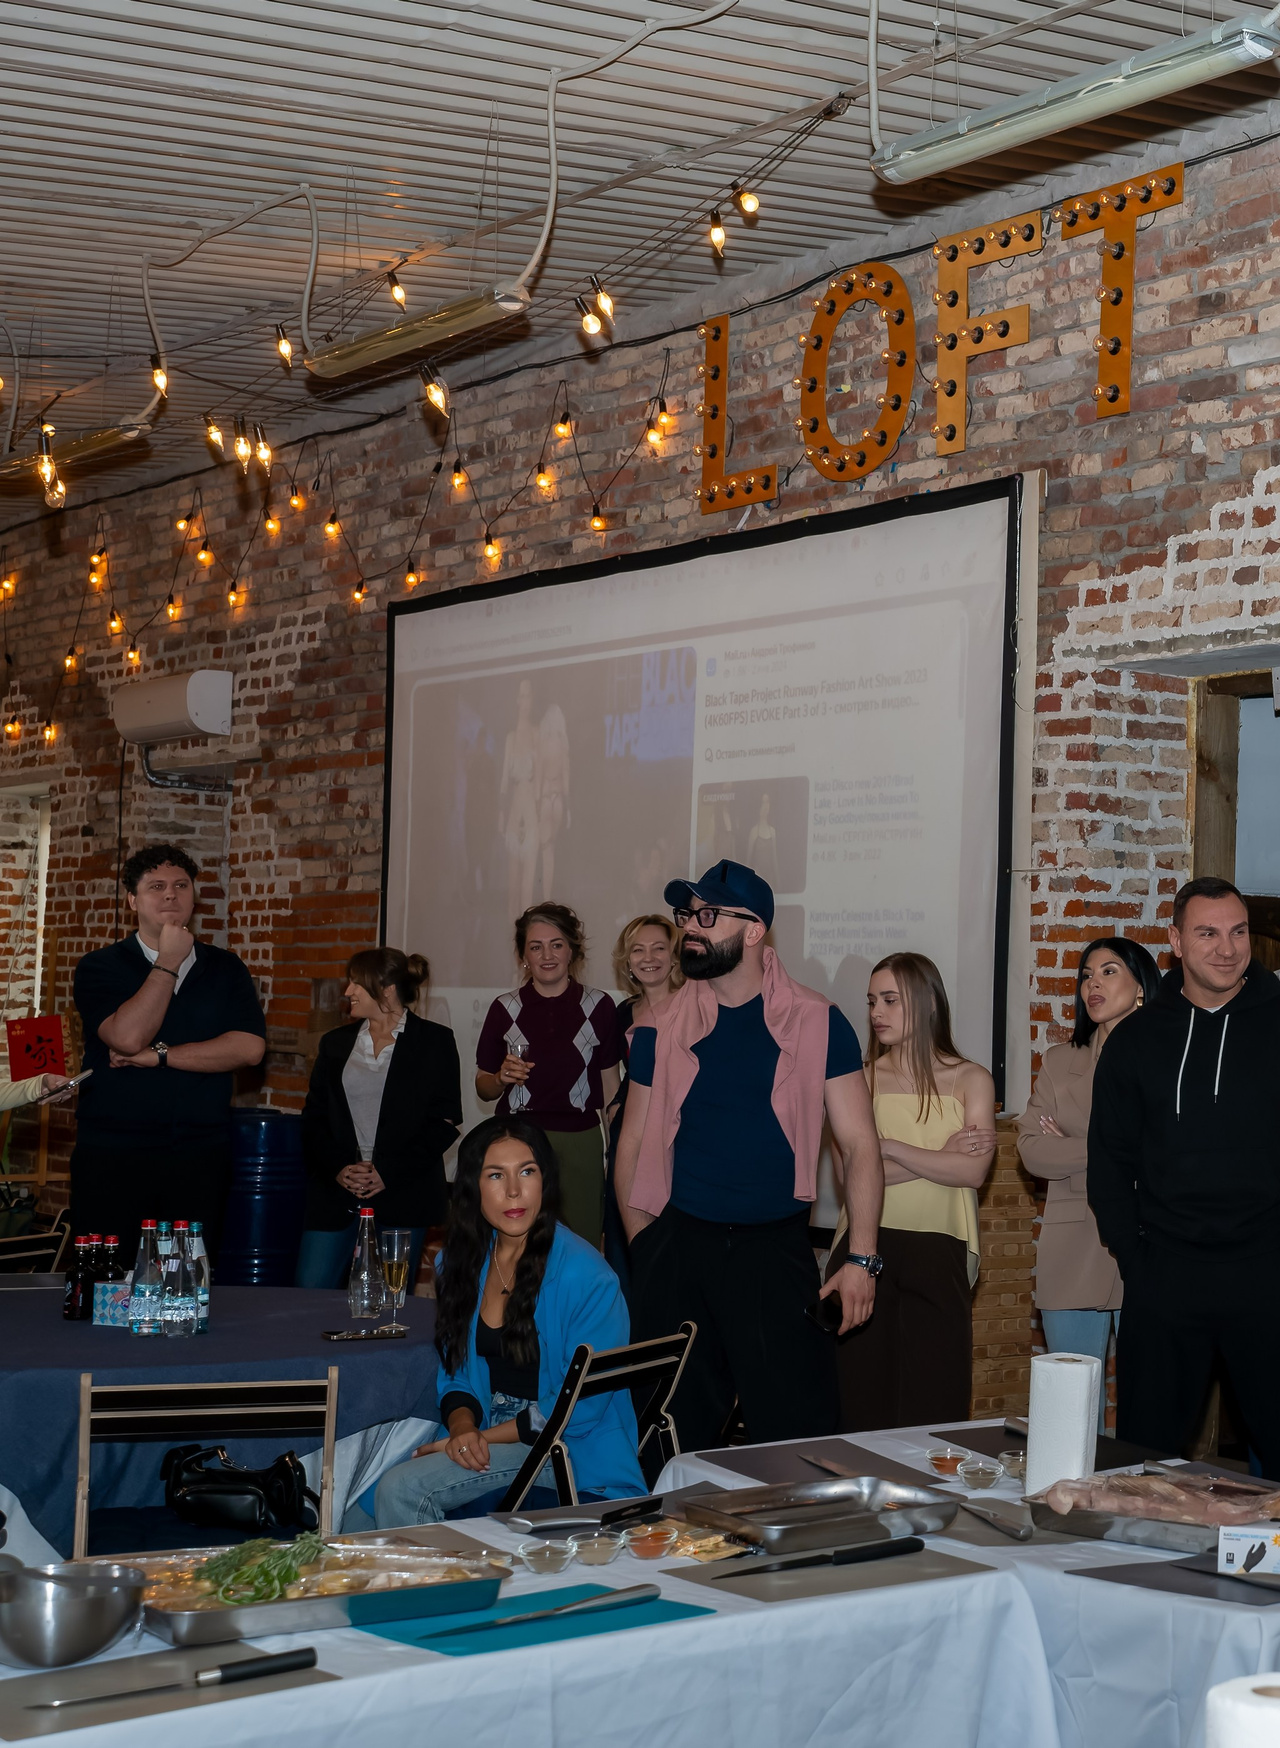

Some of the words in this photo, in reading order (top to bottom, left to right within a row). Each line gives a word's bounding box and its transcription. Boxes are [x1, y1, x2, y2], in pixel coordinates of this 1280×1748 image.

[698, 162, 1184, 514] LOFT
[705, 693, 727, 708] Black
[729, 690, 749, 707] Tape
[751, 687, 782, 704] Project
[783, 684, 819, 699] Runway
[820, 679, 856, 694] Fashion
[857, 675, 872, 690] Art
[875, 673, 901, 688] Show
[903, 667, 928, 685] 2023
[704, 710, 749, 731] (4K60FPS)
[750, 706, 780, 724] EVOKE
[782, 705, 801, 720] Part
[810, 702, 820, 717] of
[834, 699, 880, 716] смотреть
[715, 749, 747, 760] Оставить
[748, 742, 796, 757] комментарий
[832, 778, 854, 792] Disco
[837, 797, 856, 808] Love
[865, 794, 878, 806] No
[878, 792, 908, 805] Reason
[909, 790, 920, 803] To
[813, 812, 827, 827] Say
[809, 910, 840, 923] Kathryn
[882, 909, 903, 921] Black
[905, 908, 926, 922] Tape
[809, 927, 836, 940] Project
